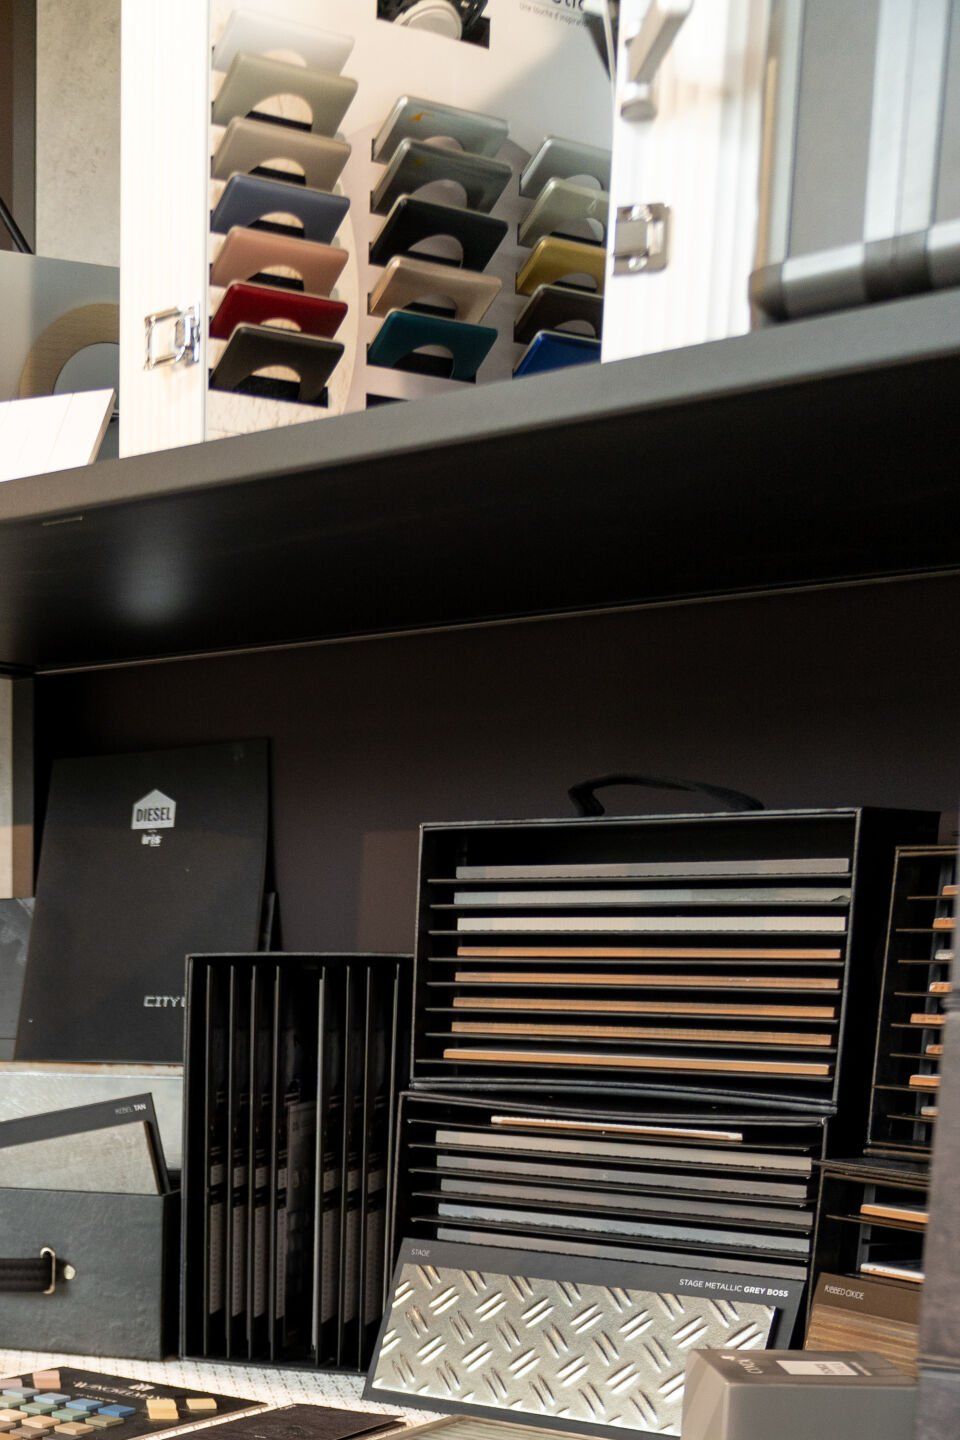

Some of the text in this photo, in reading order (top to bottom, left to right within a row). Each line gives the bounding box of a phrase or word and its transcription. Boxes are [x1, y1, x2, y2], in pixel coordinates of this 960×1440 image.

[136, 807, 172, 822] DIESEL
[133, 1103, 147, 1111] TAN
[411, 1248, 430, 1257] STAGE
[679, 1279, 790, 1297] STAGE METALLIC GREY BOSS
